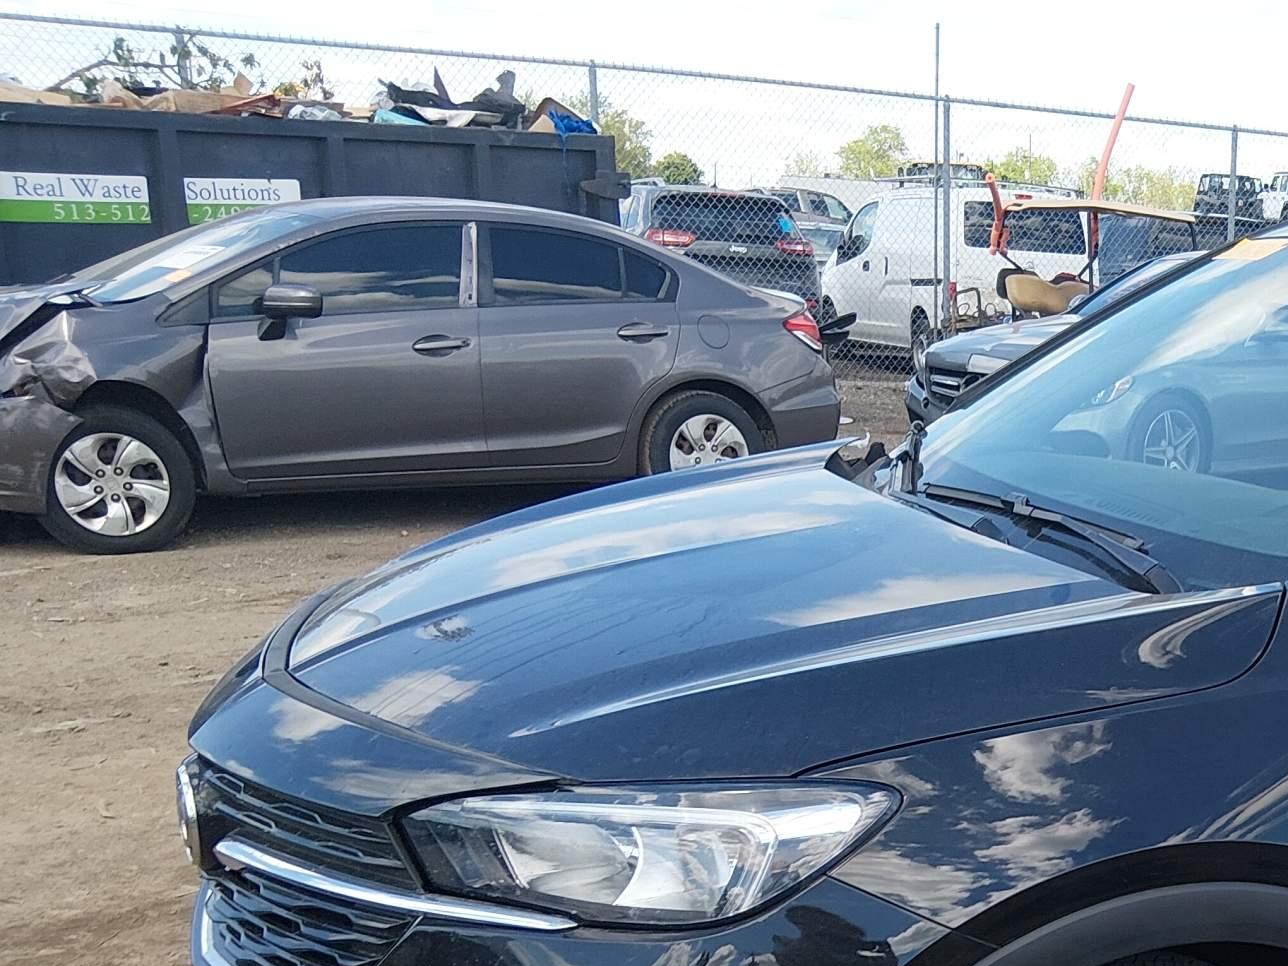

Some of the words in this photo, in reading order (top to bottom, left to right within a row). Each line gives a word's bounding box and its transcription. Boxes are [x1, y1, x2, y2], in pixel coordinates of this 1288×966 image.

[12, 176, 64, 197] Real
[70, 178, 142, 199] Waste
[186, 181, 281, 201] Solutions
[54, 203, 151, 221] 513-512
[729, 244, 747, 254] Jeep
